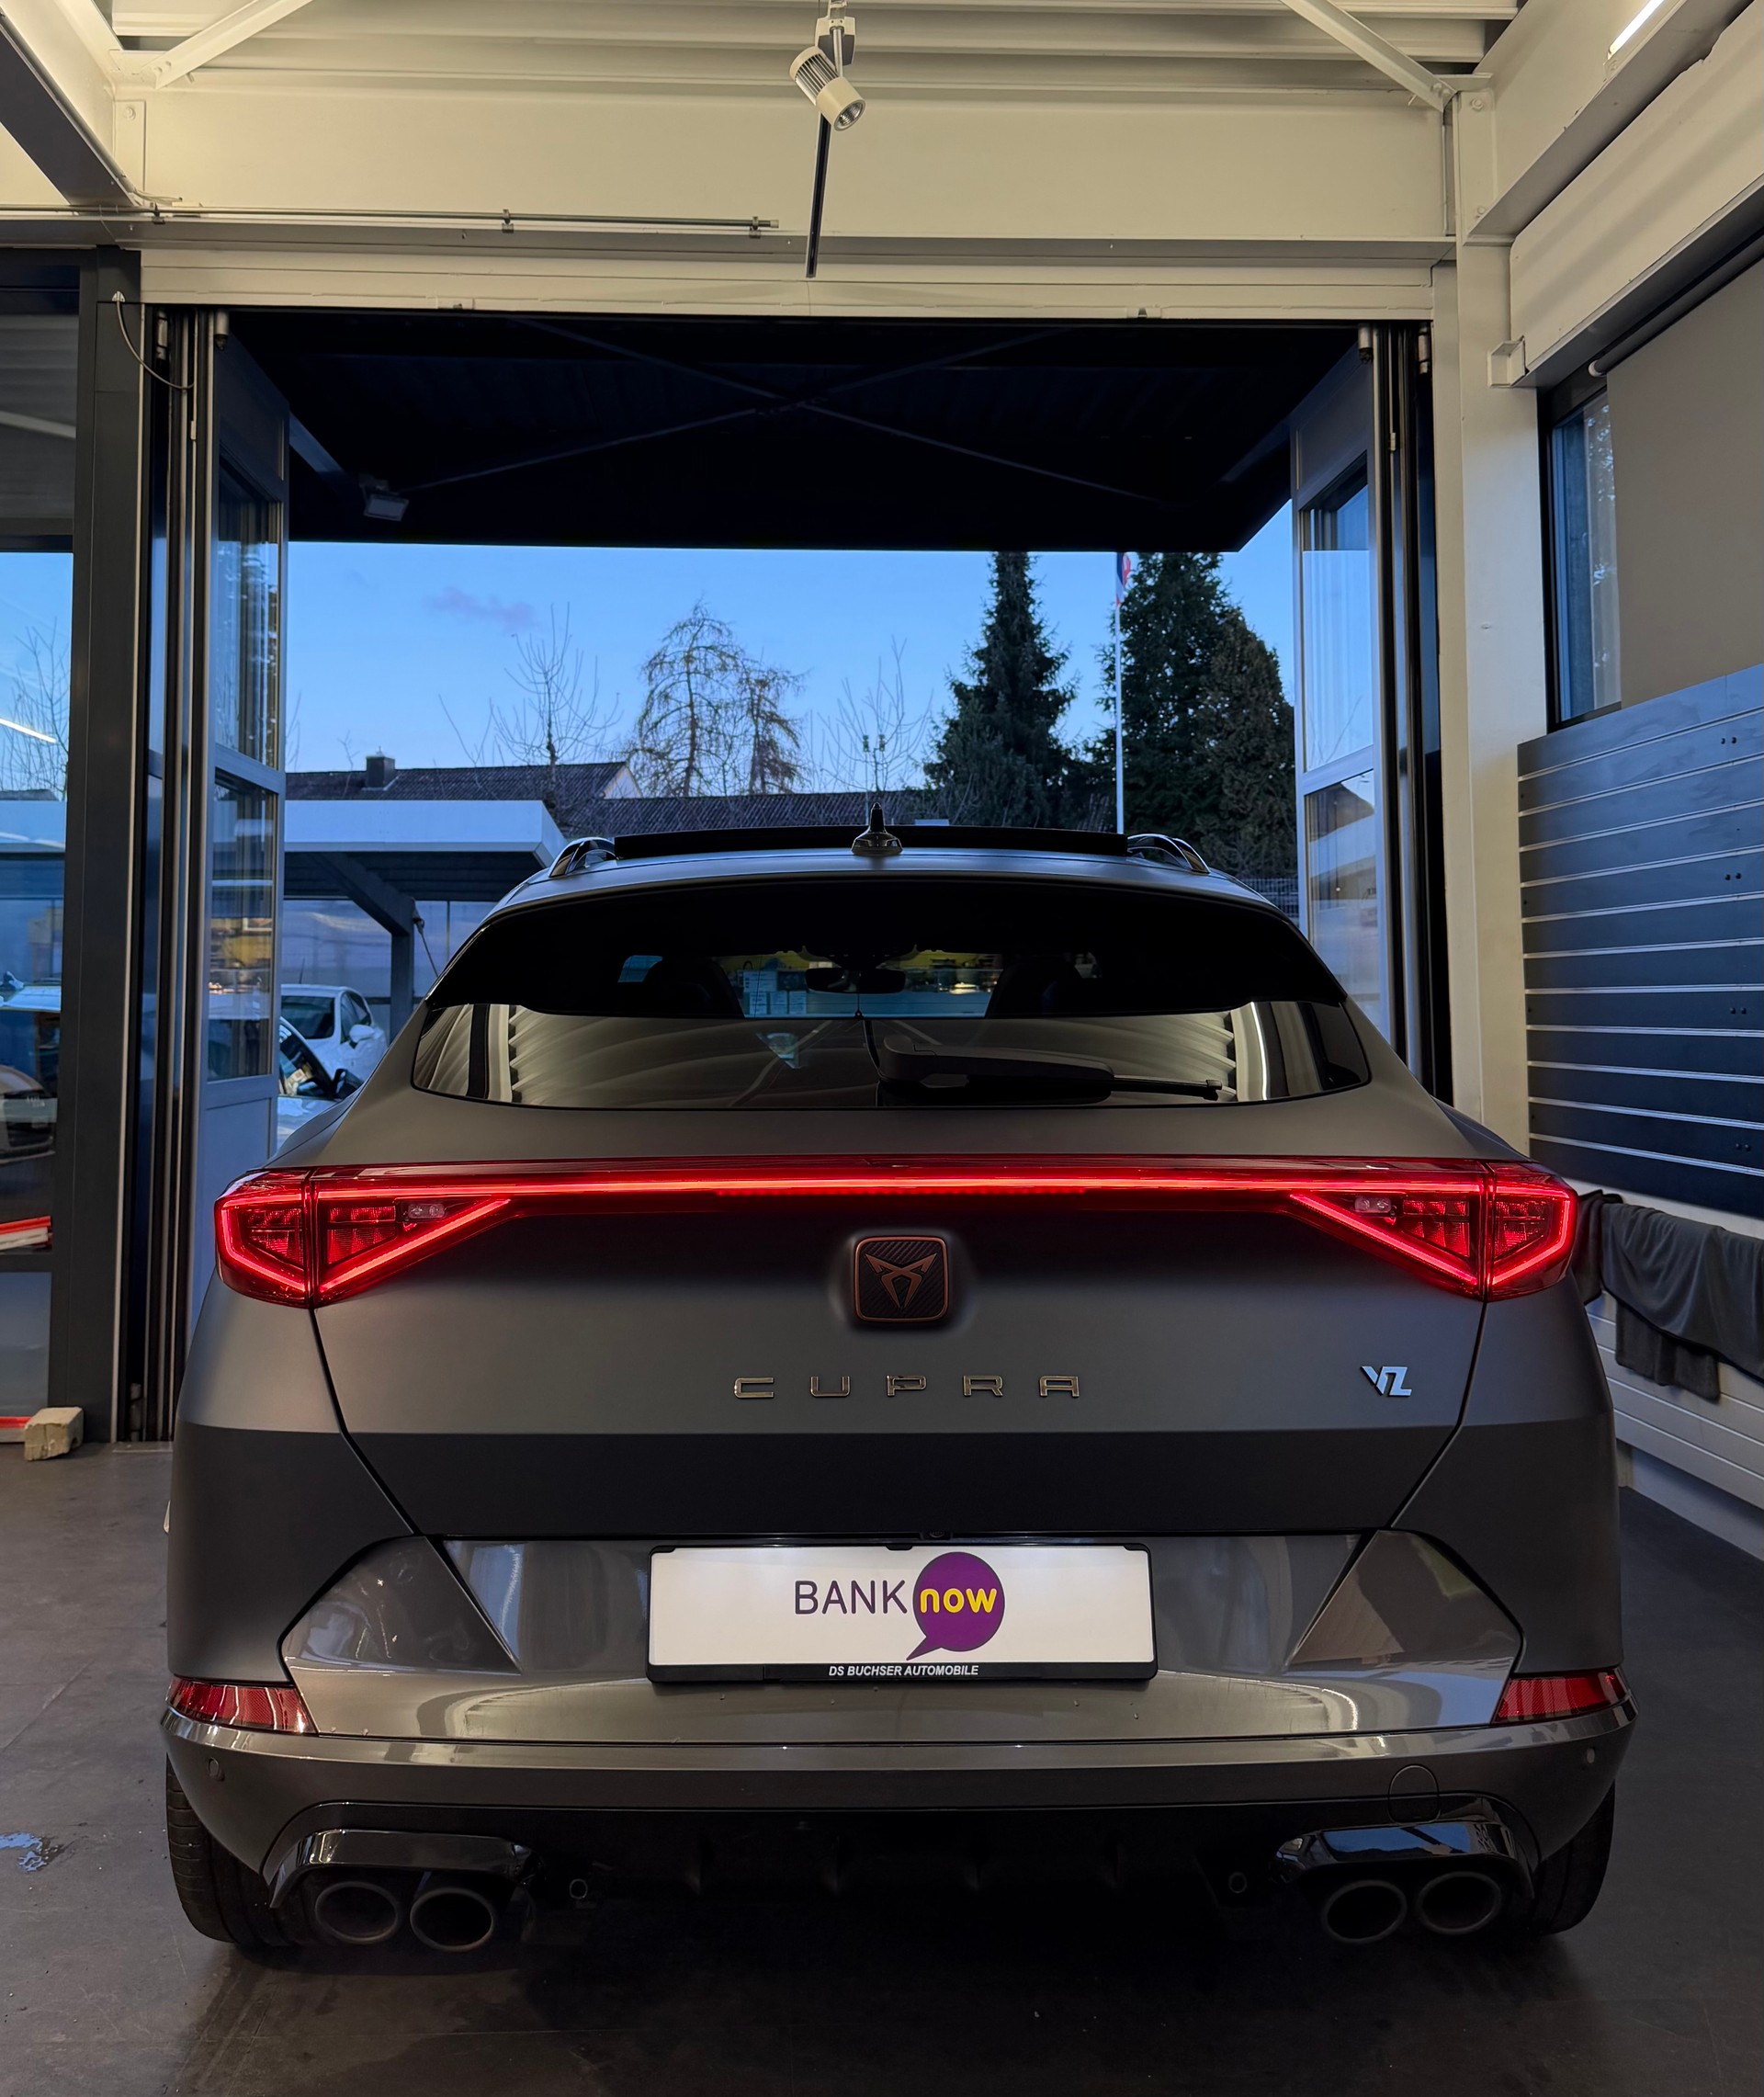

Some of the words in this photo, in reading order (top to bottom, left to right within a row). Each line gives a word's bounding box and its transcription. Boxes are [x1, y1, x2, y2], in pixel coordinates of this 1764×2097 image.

[733, 1375, 1080, 1398] CUPRA
[1361, 1366, 1412, 1396] VZ
[795, 1580, 908, 1615] BANK
[920, 1588, 997, 1614] now
[829, 1665, 844, 1676] DS
[847, 1665, 902, 1676] BUCHSER
[903, 1665, 979, 1676] AUTOMOBILE
